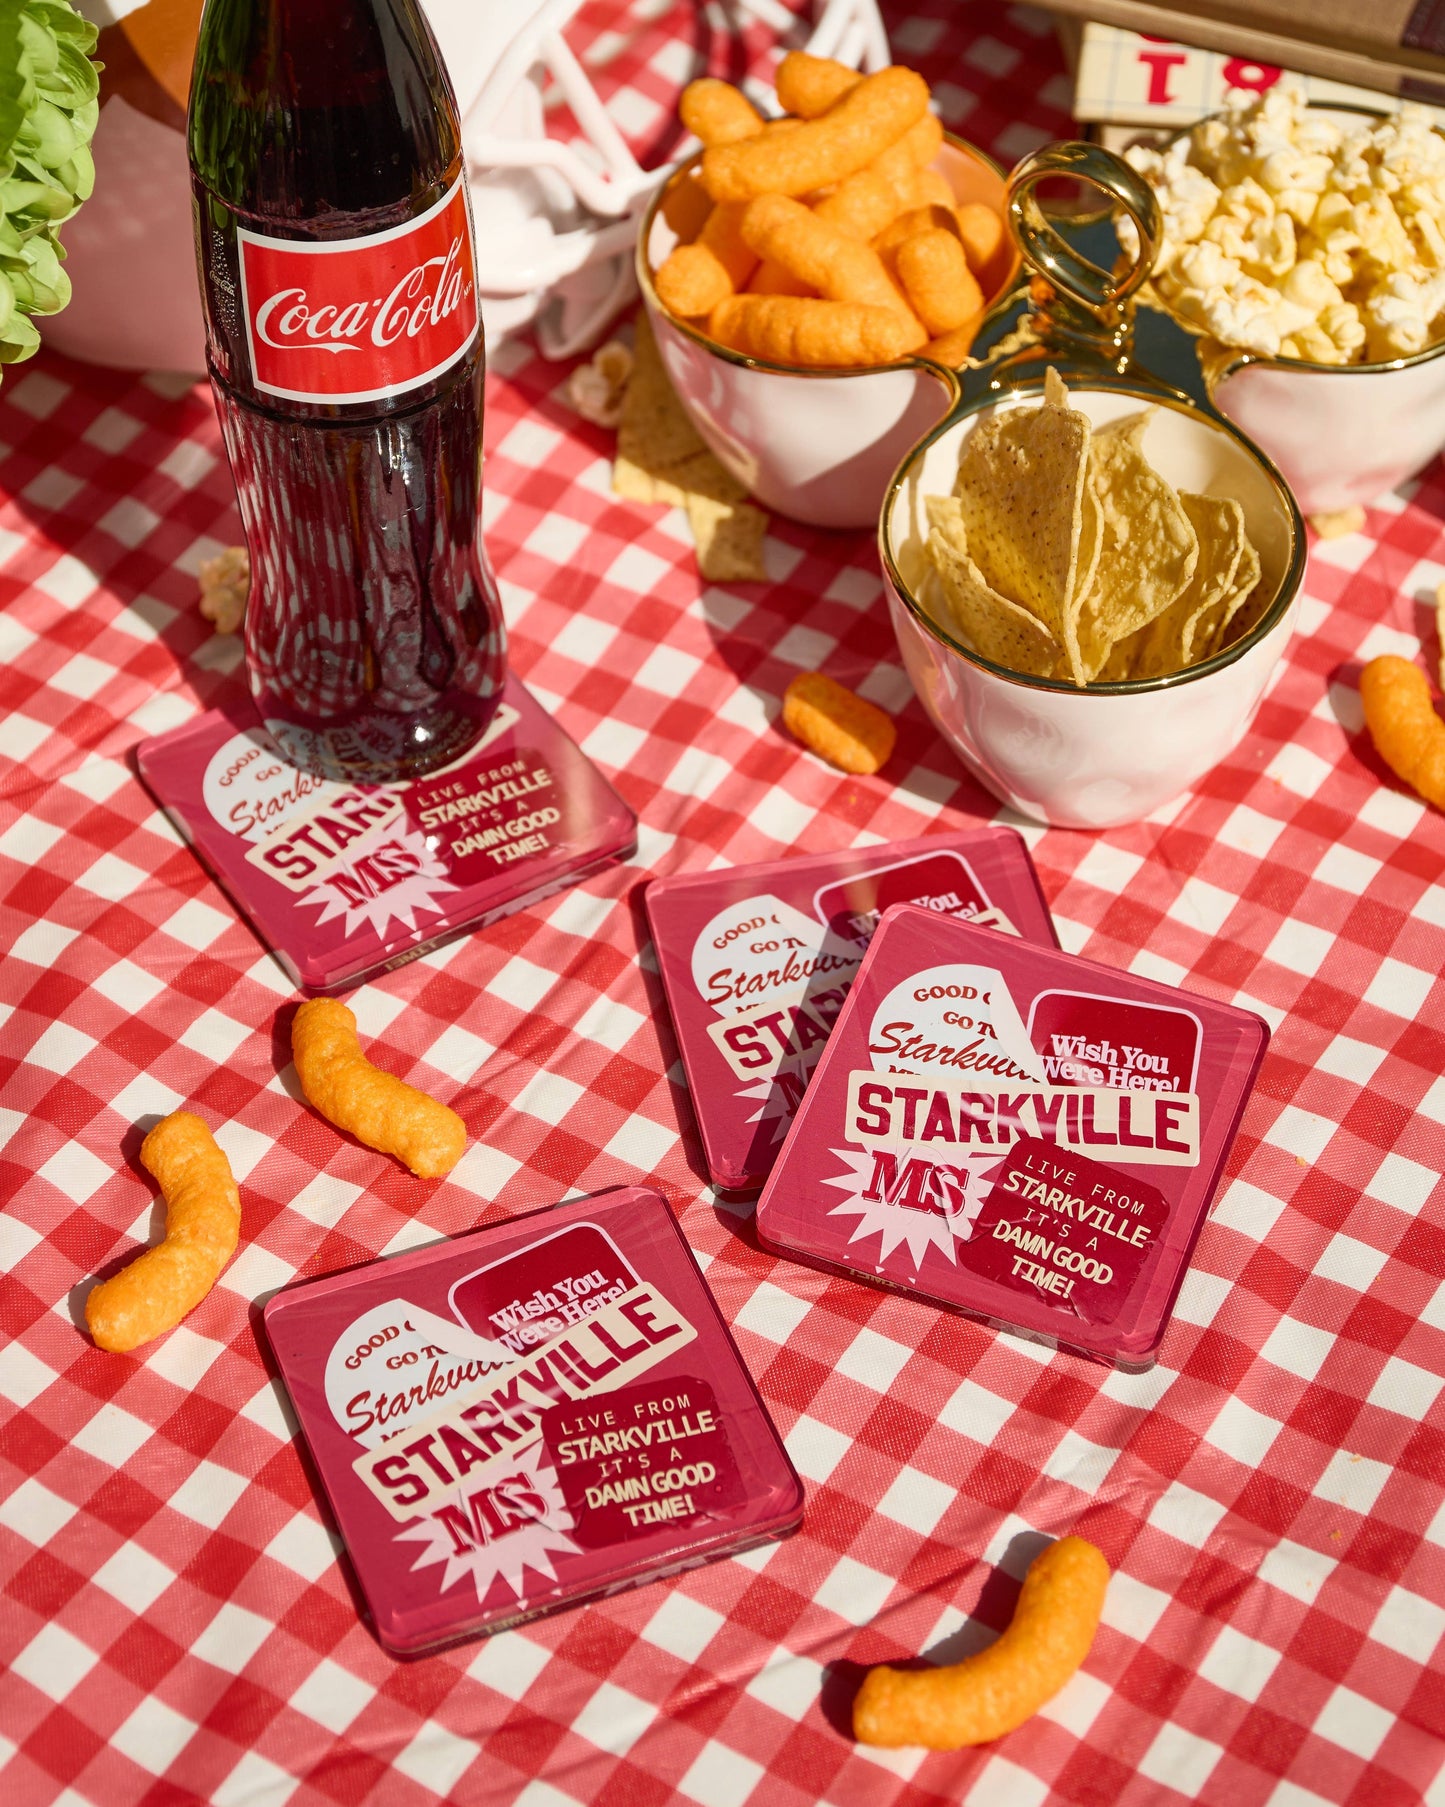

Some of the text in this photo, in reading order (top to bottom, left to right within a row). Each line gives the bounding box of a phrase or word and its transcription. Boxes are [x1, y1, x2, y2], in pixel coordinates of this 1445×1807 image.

[256, 231, 464, 354] Coca-Cola
[219, 749, 261, 787] GOOD
[255, 765, 282, 782] GO
[418, 760, 526, 807] LIVE FROM
[419, 769, 552, 829] STARKVILLE
[457, 801, 529, 833] IT'S A
[451, 807, 560, 858] DAMN GOOD
[487, 833, 549, 864] TIME!
[324, 840, 423, 910] MS
[713, 916, 766, 949] GOOD
[750, 941, 780, 954] GO
[913, 985, 977, 1002] GOOD
[943, 1011, 974, 1030] GO
[1039, 1055, 1180, 1092] Were Here!
[1051, 1034, 1169, 1074] Wish You
[856, 1083, 1190, 1154] STARKVILLE
[861, 1150, 970, 1218] MS
[1025, 1155, 1145, 1216] LIVE FROM
[1002, 1170, 1151, 1249] STARKVILLE
[1023, 1207, 1098, 1251] IT'S A
[993, 1220, 1114, 1285] DAMN GOOD
[1010, 1255, 1074, 1299] TIME!
[488, 1270, 609, 1333] Wish You
[498, 1278, 628, 1351] Were Here!
[345, 1326, 400, 1370] GOOD
[386, 1352, 418, 1370] GO
[371, 1293, 683, 1505] STARKVILLE
[561, 1394, 691, 1435] LIVE FROM
[557, 1410, 716, 1465] STARKVILLE
[598, 1447, 682, 1478] IT'S A
[585, 1462, 716, 1510] DAMN GOOD
[432, 1472, 550, 1557] MS
[622, 1494, 695, 1527] TIME!
